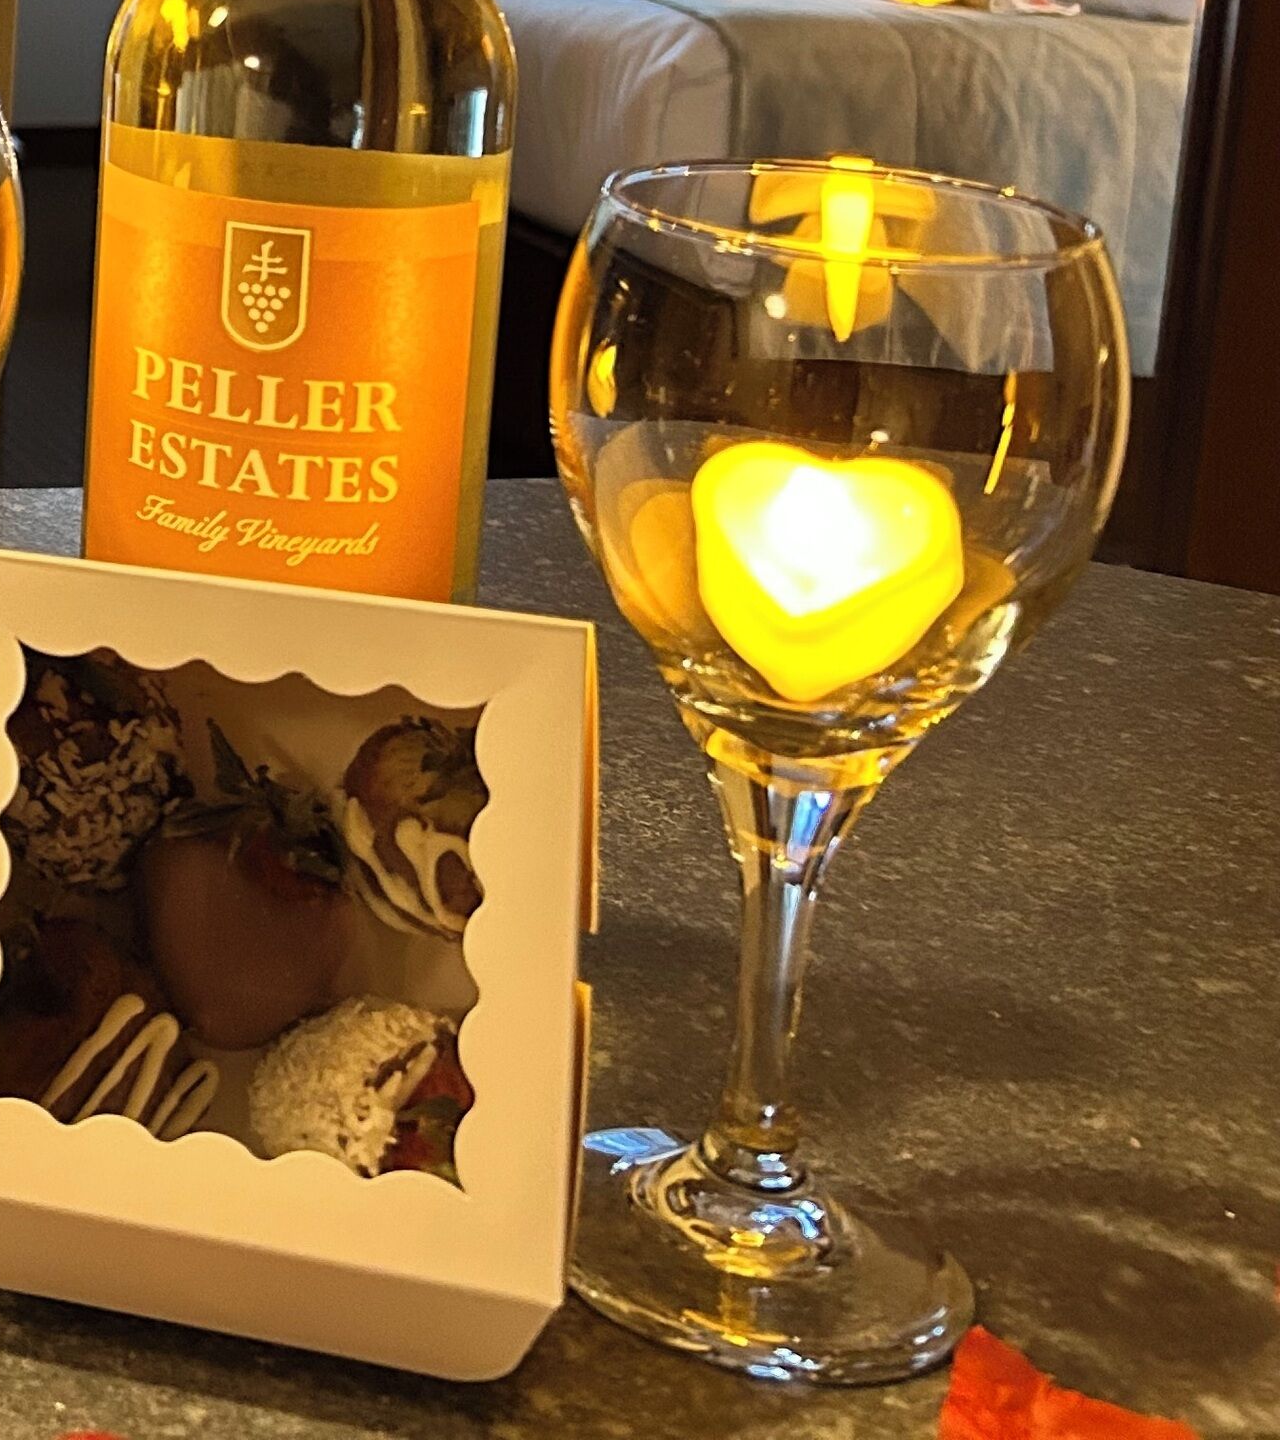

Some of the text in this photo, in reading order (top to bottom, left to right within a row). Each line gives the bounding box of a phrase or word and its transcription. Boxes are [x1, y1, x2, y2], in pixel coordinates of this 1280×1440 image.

[132, 346, 402, 433] PELLER
[128, 419, 399, 503] ESTATES
[136, 494, 380, 567] Family Vineyards
